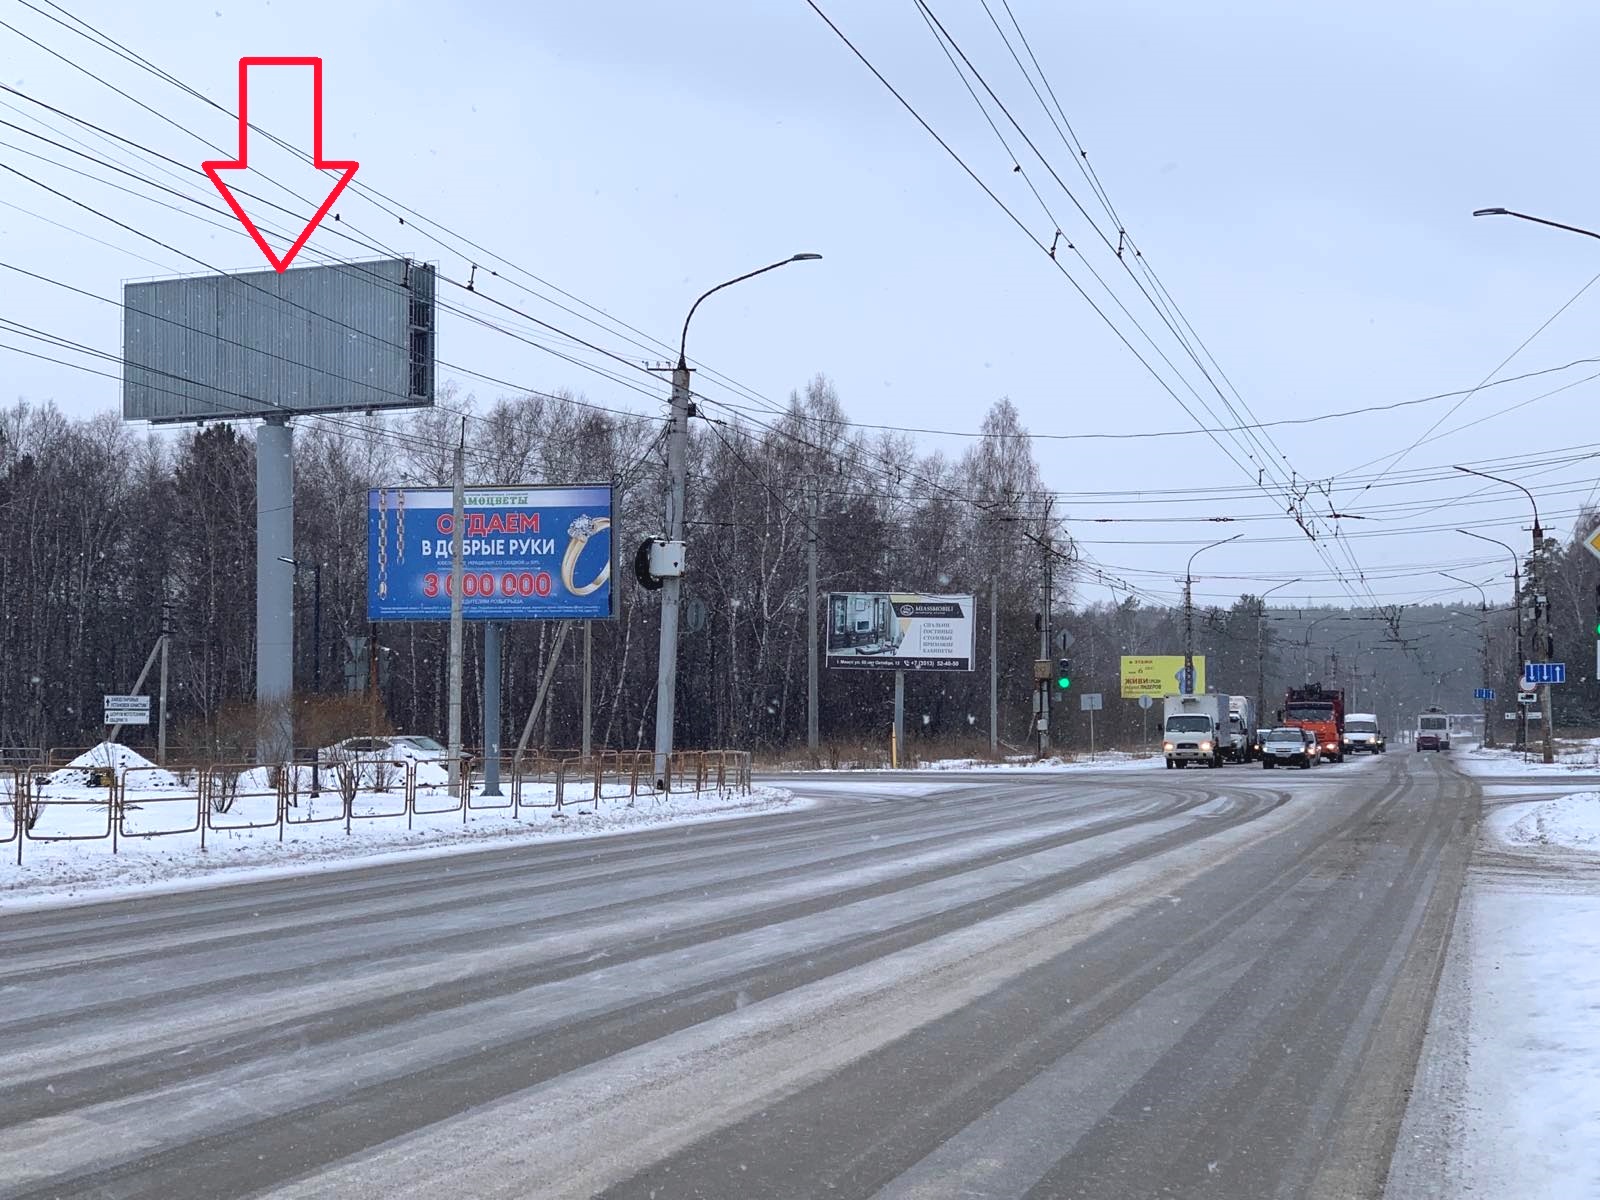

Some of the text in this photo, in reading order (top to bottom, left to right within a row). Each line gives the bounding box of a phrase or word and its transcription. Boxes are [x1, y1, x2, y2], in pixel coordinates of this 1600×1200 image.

[421, 540, 432, 556] В
[509, 538, 555, 555] РУКИ
[423, 573, 439, 597] 3
[501, 572, 552, 597] 000
